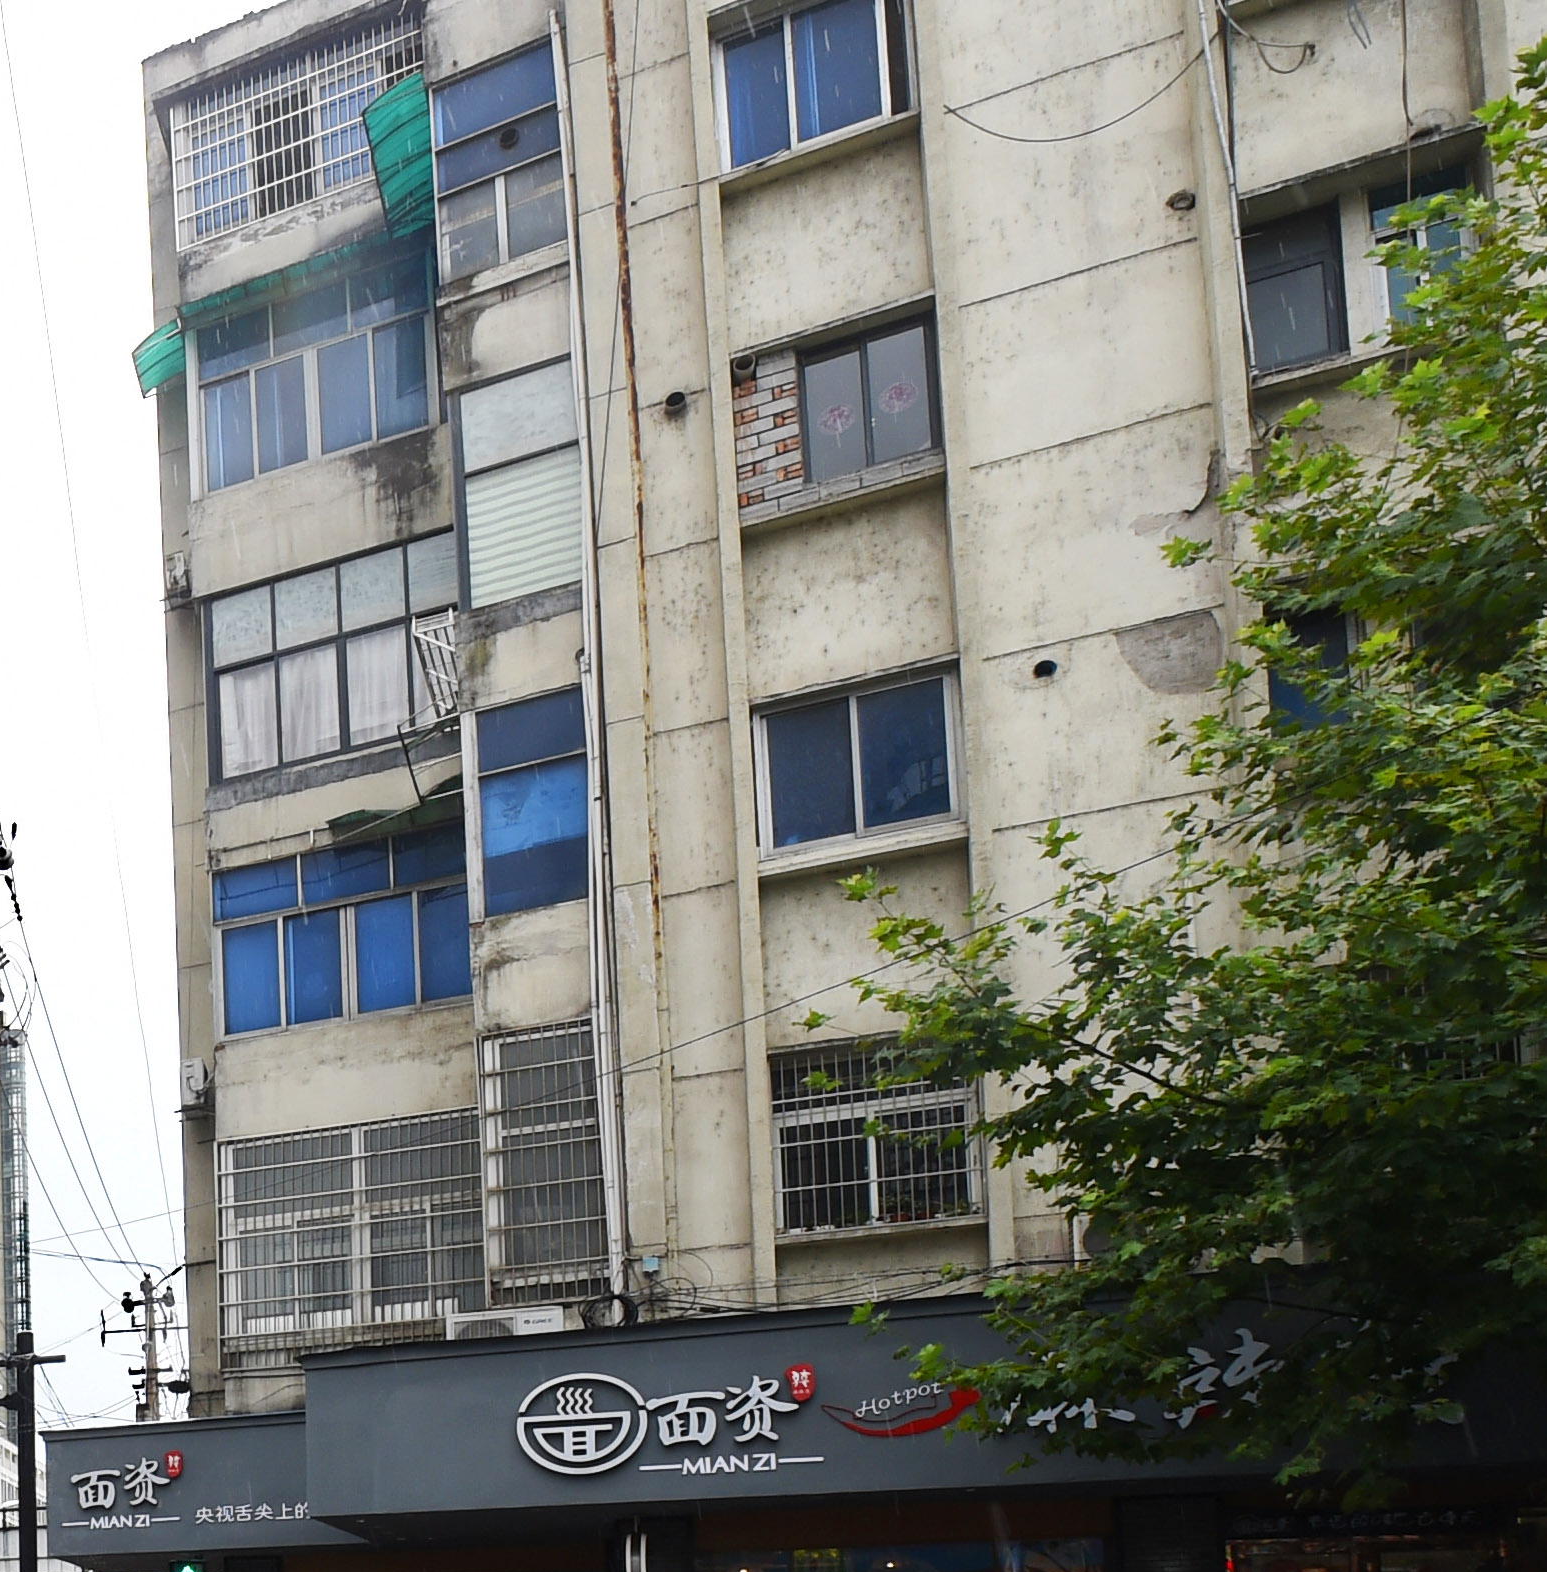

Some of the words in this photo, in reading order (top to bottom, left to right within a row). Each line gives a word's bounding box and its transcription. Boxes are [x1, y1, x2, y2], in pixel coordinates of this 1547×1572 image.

[645, 1376, 800, 1446] 面资
[855, 1382, 944, 1418] Hotpot
[681, 1455, 750, 1476] MIAN
[753, 1453, 777, 1471] ZI
[70, 1457, 171, 1510] 面资
[89, 1515, 134, 1530] MIAN
[134, 1513, 151, 1527] ZI
